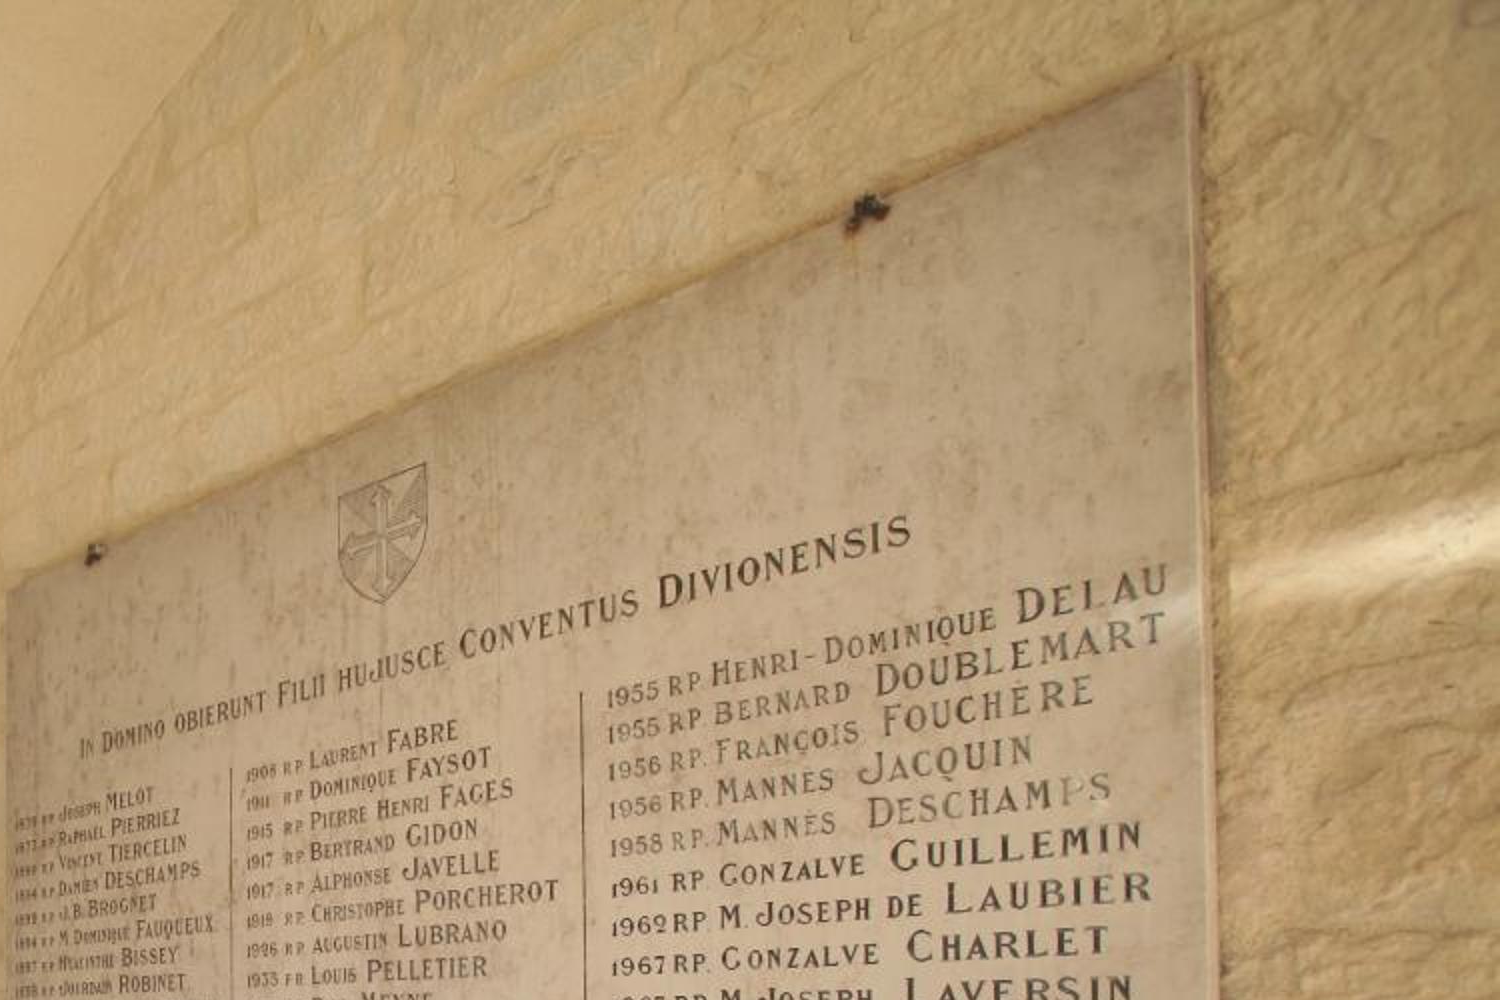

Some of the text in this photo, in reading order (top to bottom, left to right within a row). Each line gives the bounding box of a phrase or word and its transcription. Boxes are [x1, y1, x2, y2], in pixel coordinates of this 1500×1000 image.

[79, 515, 912, 760] IN DOMINO OBIERUNT FILII HUJUSCE CONVENTUS DIVIONENSIS
[607, 680, 658, 708] 1955
[712, 608, 993, 685] HENRI-DOMINIQUE
[1017, 565, 1164, 623] DELAU
[608, 716, 660, 744] 1955
[715, 681, 849, 724] BERNARD
[877, 613, 1160, 695] DOUBLEMART
[309, 741, 375, 769] LAURENT
[387, 719, 457, 752] FABRE
[608, 755, 661, 781] 1956
[716, 721, 858, 763] FRANÇOIS
[310, 769, 395, 799] DOMINIQUE
[407, 746, 490, 781] FAYSOT
[609, 795, 661, 820] 1956
[857, 736, 1030, 784] JACQUIN
[310, 806, 365, 829] PIERRE
[377, 795, 428, 820] HENRI
[440, 777, 512, 809] FAGES
[610, 832, 662, 857] 1958
[868, 774, 1109, 828] DESCHAMPS
[109, 834, 186, 862] TIERCELIN
[310, 834, 394, 861] BERTRAND
[405, 819, 476, 846] GIDON
[611, 876, 657, 898] 1961
[719, 854, 863, 886] GONZALVE
[890, 823, 1138, 870] GUILLEMIN
[105, 860, 200, 889] DESCHAMPS
[310, 867, 390, 893] ALPHONSE
[402, 849, 498, 880] JAVELLE
[311, 899, 403, 922] CHRISTOPHE
[415, 879, 557, 912] PORCHEROT
[756, 898, 869, 926] JOSEPH
[887, 893, 921, 918] DE
[947, 874, 1148, 913] LAUBIER
[121, 945, 179, 966] BISSEY
[312, 932, 386, 953] AUGUSTIN
[398, 920, 506, 947] LUBRANO
[612, 955, 664, 976] 1967
[721, 943, 877, 970] GONZALVE
[907, 926, 1104, 961] CHARLET
[119, 973, 184, 993] ROBINET
[311, 965, 356, 985] LOUIS
[367, 956, 486, 981] PELLETIER
